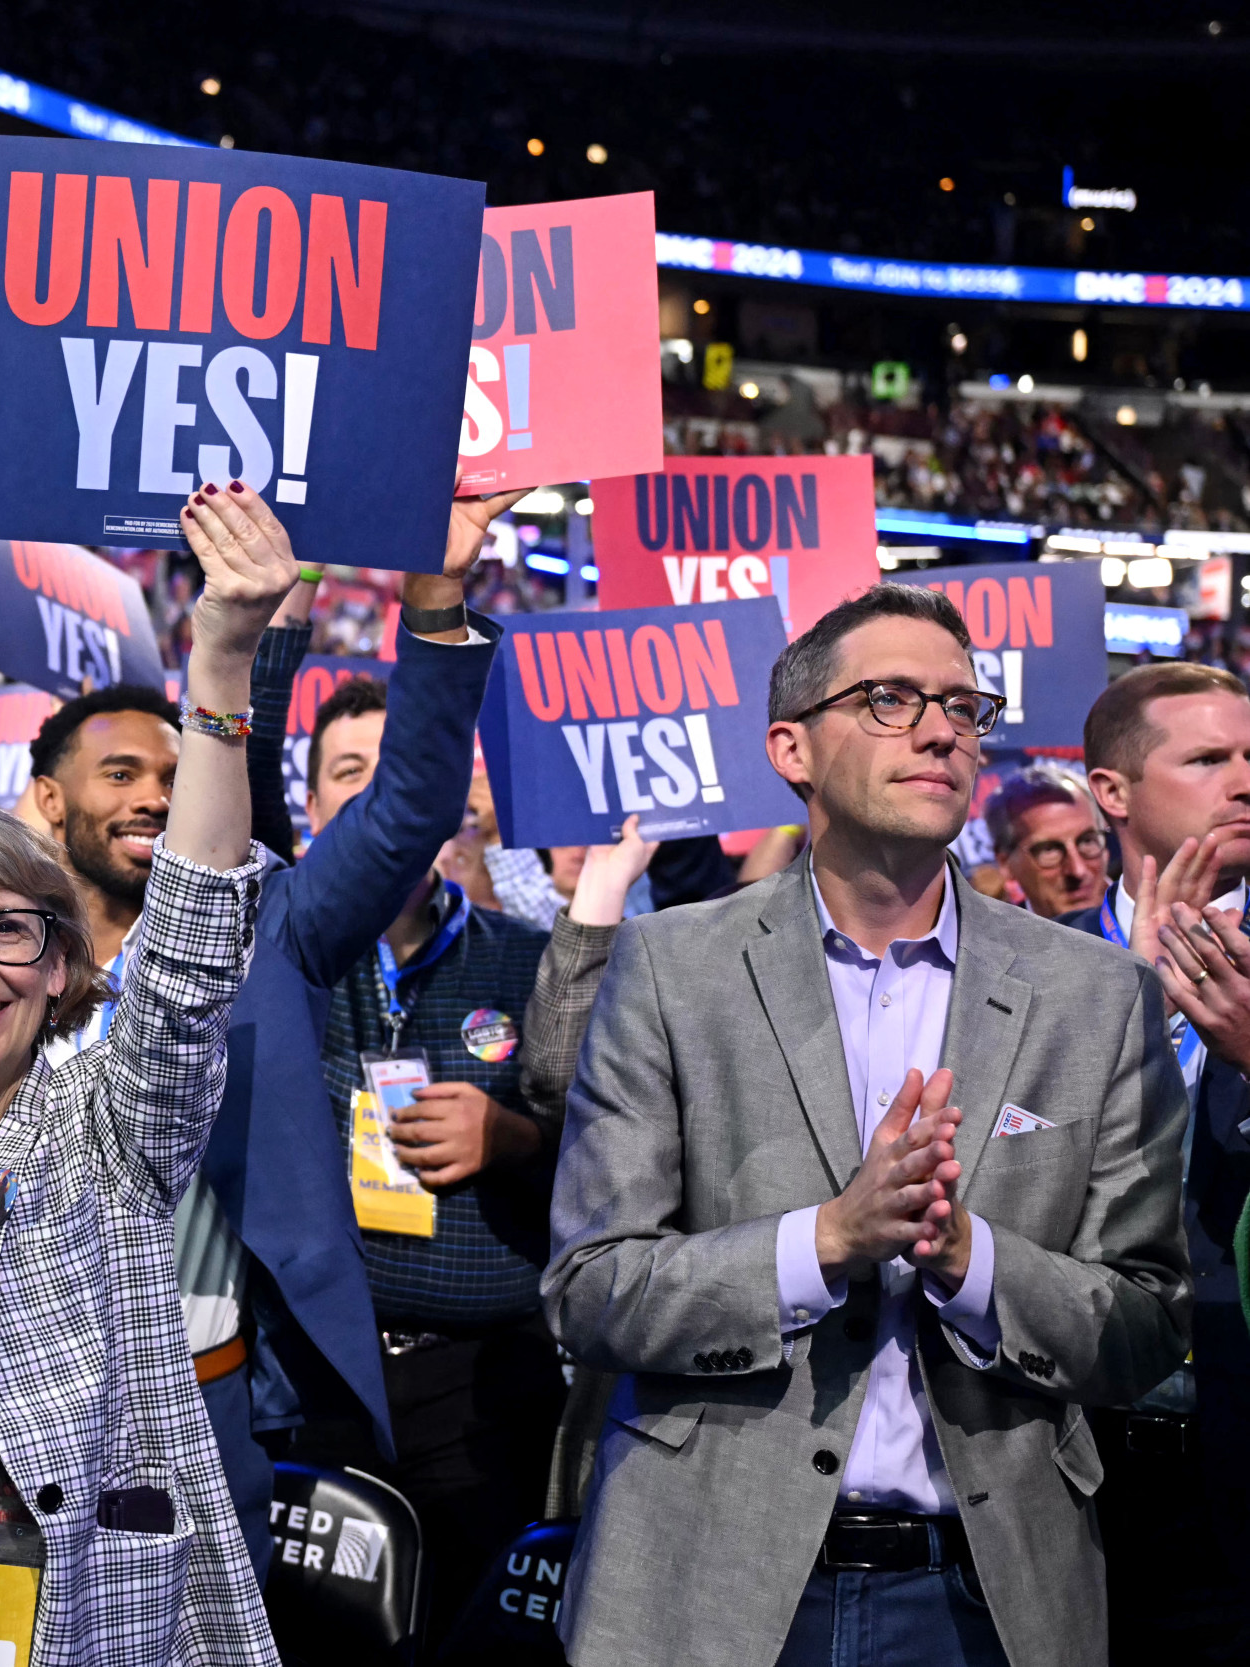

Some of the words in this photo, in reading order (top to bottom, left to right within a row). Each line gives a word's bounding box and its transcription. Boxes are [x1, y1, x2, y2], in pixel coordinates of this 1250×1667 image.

[4, 171, 388, 350] UNION
[1165, 276, 1244, 307] 2024
[60, 337, 320, 506] YES!
[635, 473, 820, 552] UNION
[36, 595, 123, 691] YES!
[512, 619, 740, 722] UNION
[561, 714, 725, 815] YES!
[274, 1536, 325, 1571] ER
[507, 1552, 562, 1586] UN
